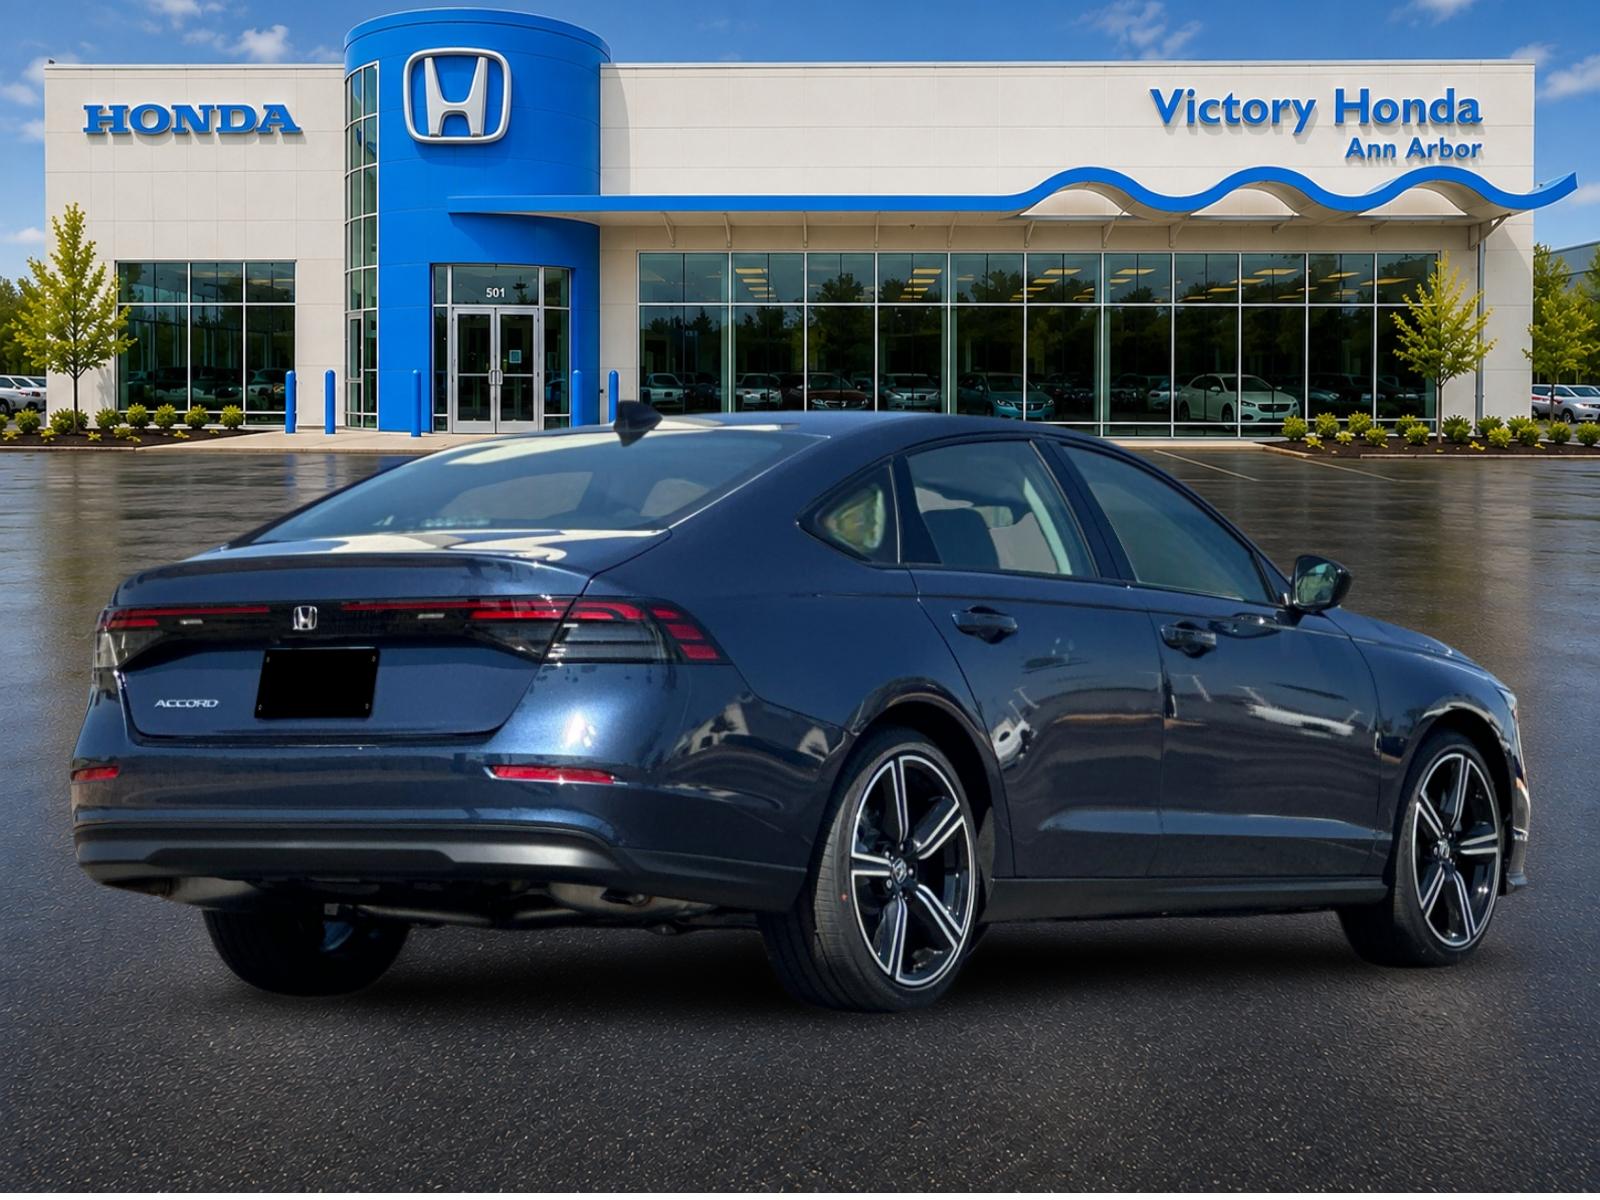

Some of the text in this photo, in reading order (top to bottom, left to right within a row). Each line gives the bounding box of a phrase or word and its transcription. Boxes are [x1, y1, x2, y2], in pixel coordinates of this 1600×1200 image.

[83, 103, 302, 135] HONDA
[1150, 87, 1483, 135] Victory Honda
[1345, 137, 1483, 160] Ann Arbor
[486, 287, 505, 298] 501
[155, 699, 219, 708] ACCORD
